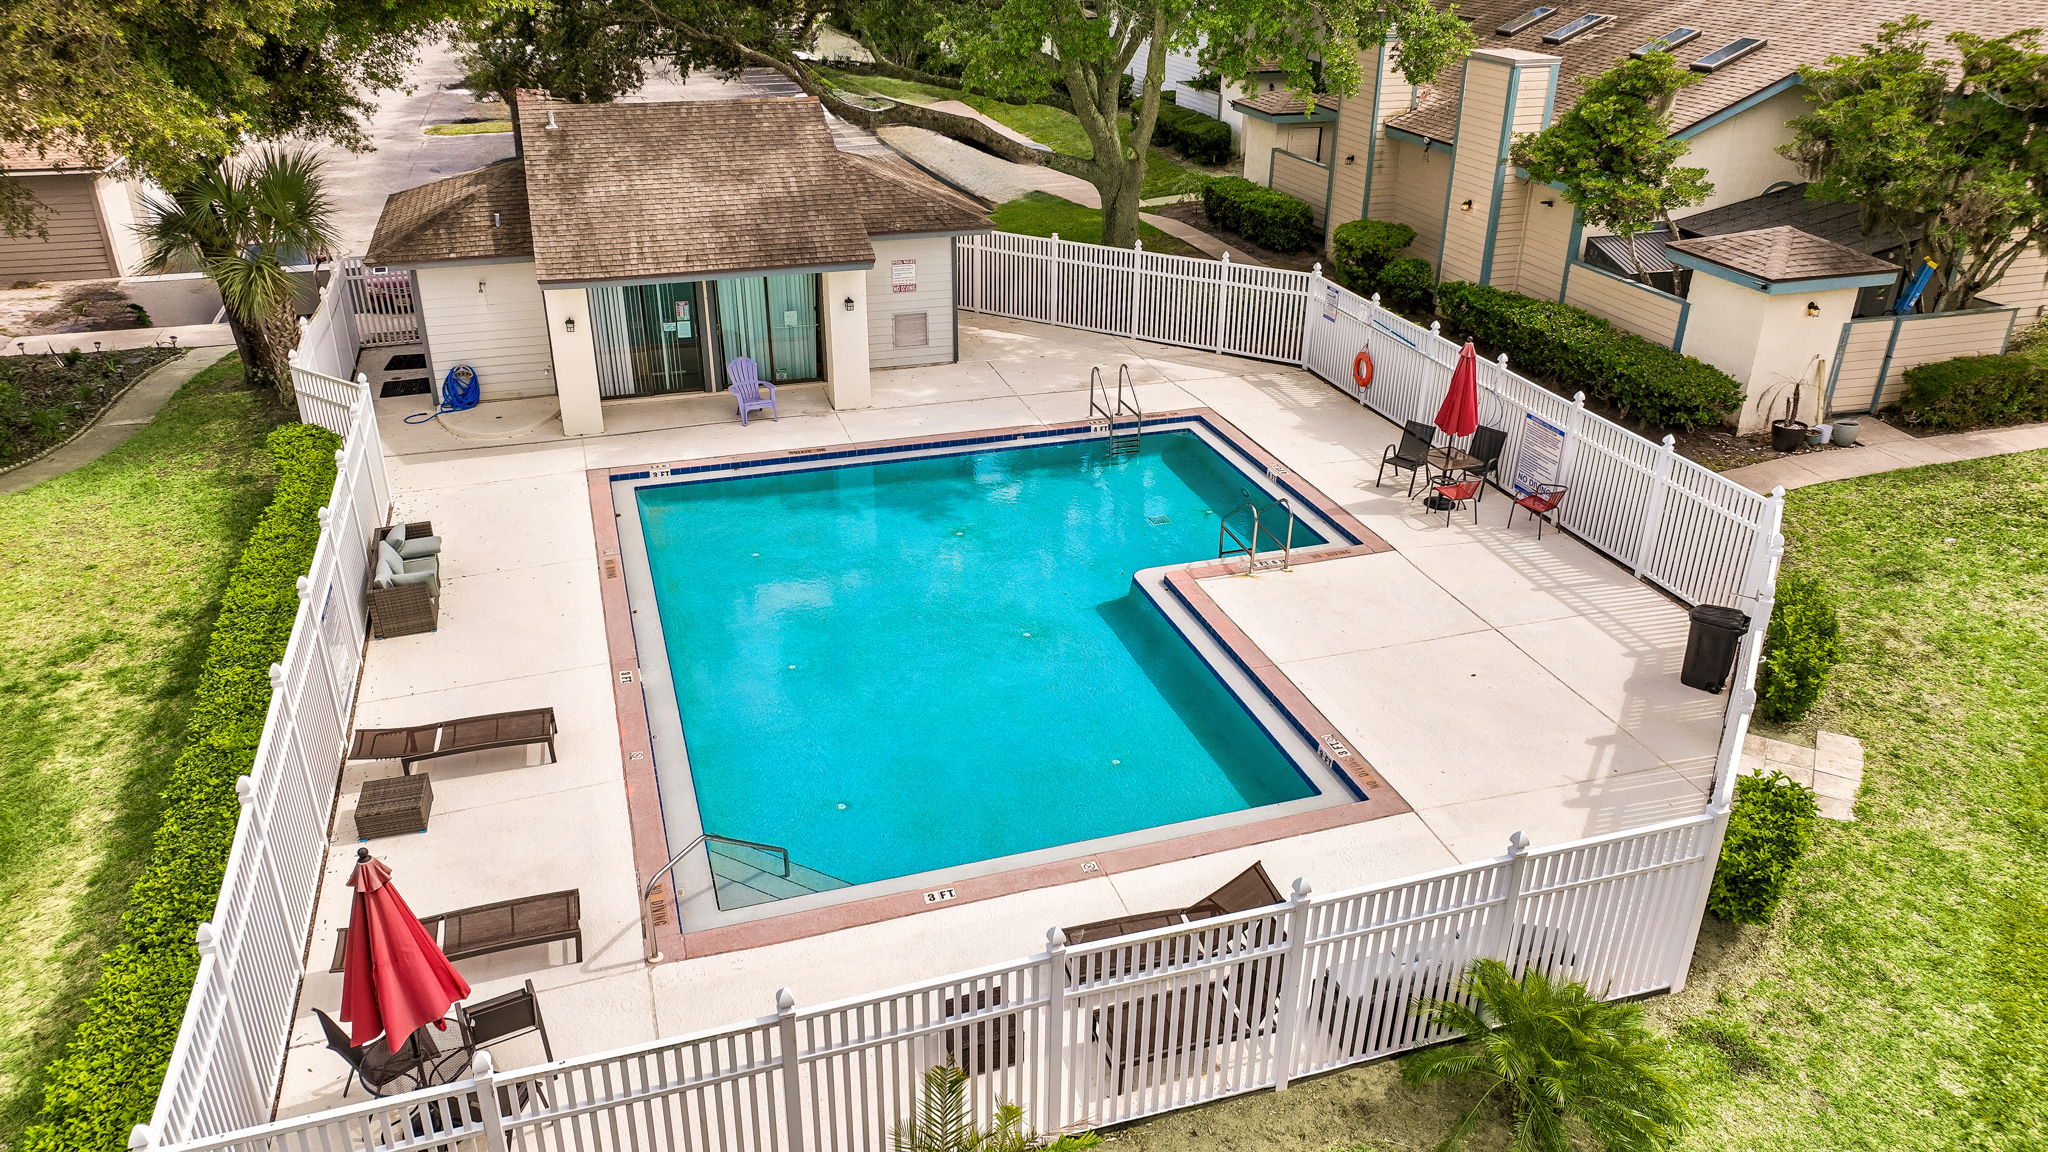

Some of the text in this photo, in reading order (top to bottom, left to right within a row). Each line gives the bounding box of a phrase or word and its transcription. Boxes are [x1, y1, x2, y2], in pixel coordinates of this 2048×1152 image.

[901, 284, 916, 292] DIVING
[1518, 472, 1528, 483] NO
[1344, 757, 1380, 790] NO DIVING
[927, 893, 936, 901] 3
[651, 899, 668, 927] DIVING
